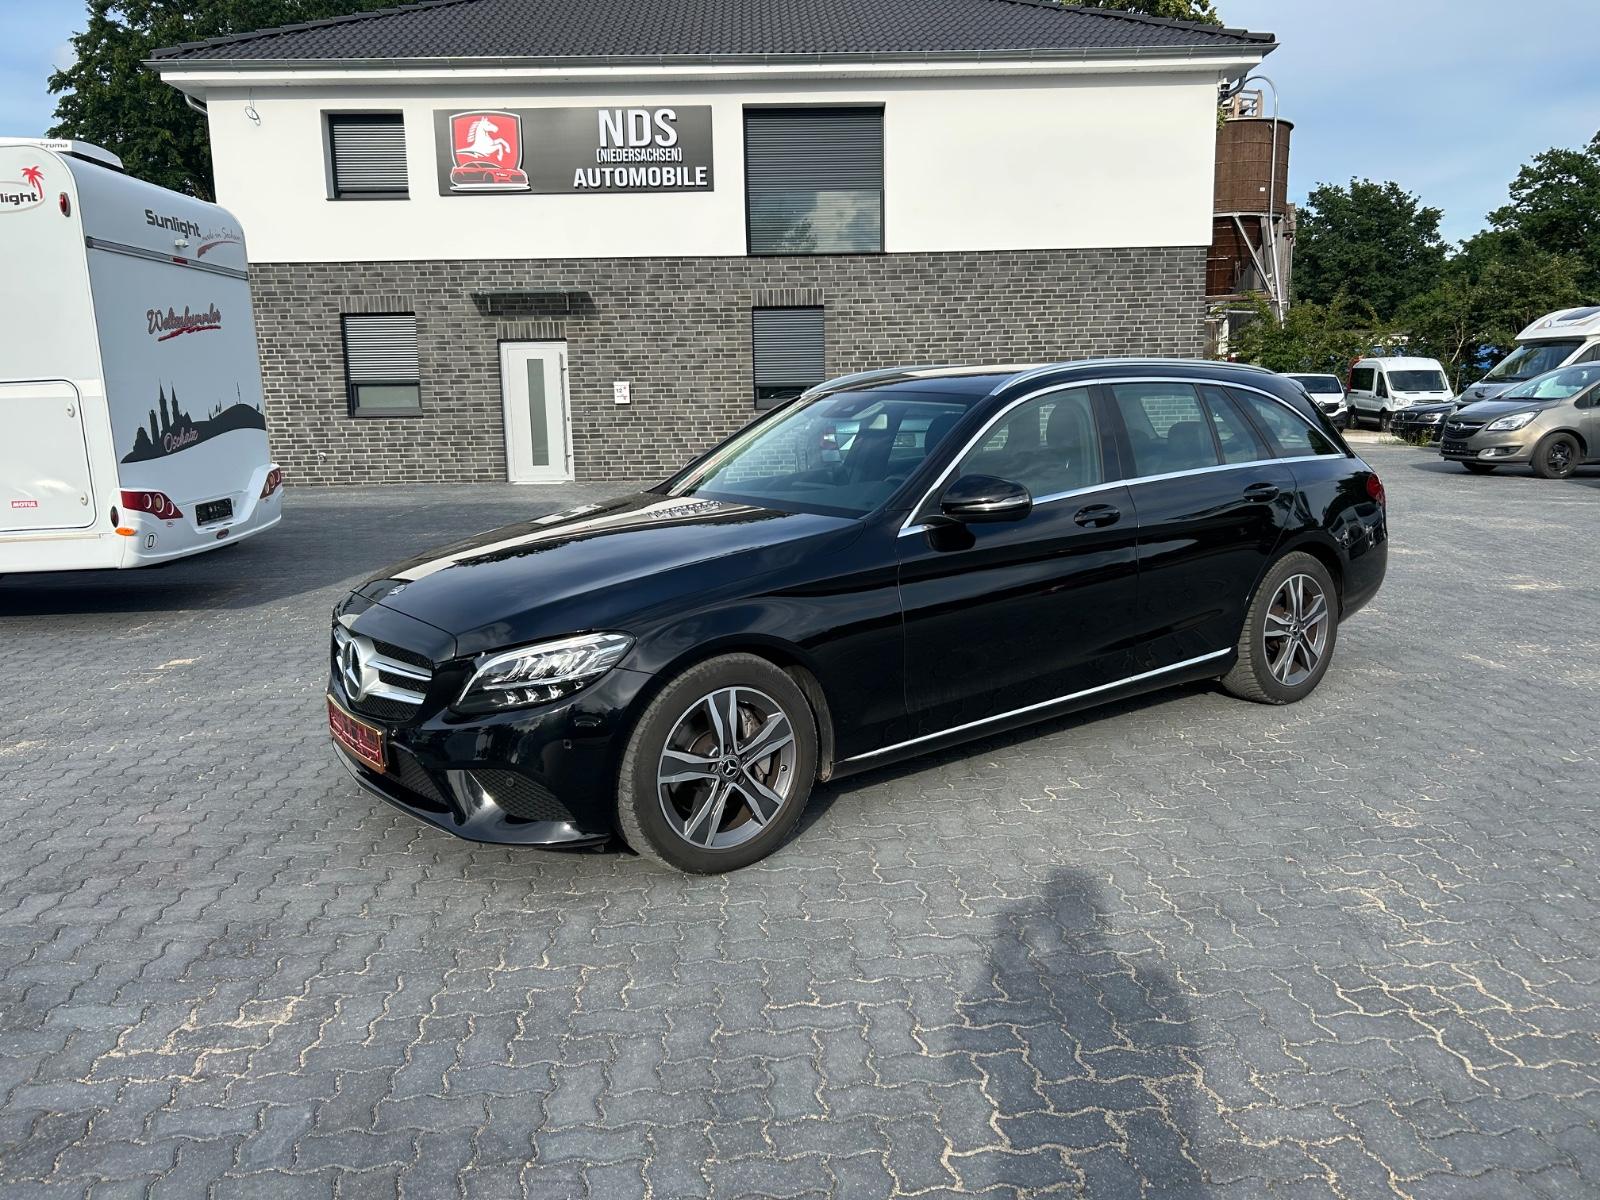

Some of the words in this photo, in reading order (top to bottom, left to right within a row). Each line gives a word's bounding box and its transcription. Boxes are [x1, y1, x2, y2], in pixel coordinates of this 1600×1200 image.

[598, 109, 678, 148] NDS
[596, 147, 683, 163] (NIEDERSACHSEN)
[573, 166, 708, 188] AUTOMOBILE
[145, 208, 201, 239] Sunlight
